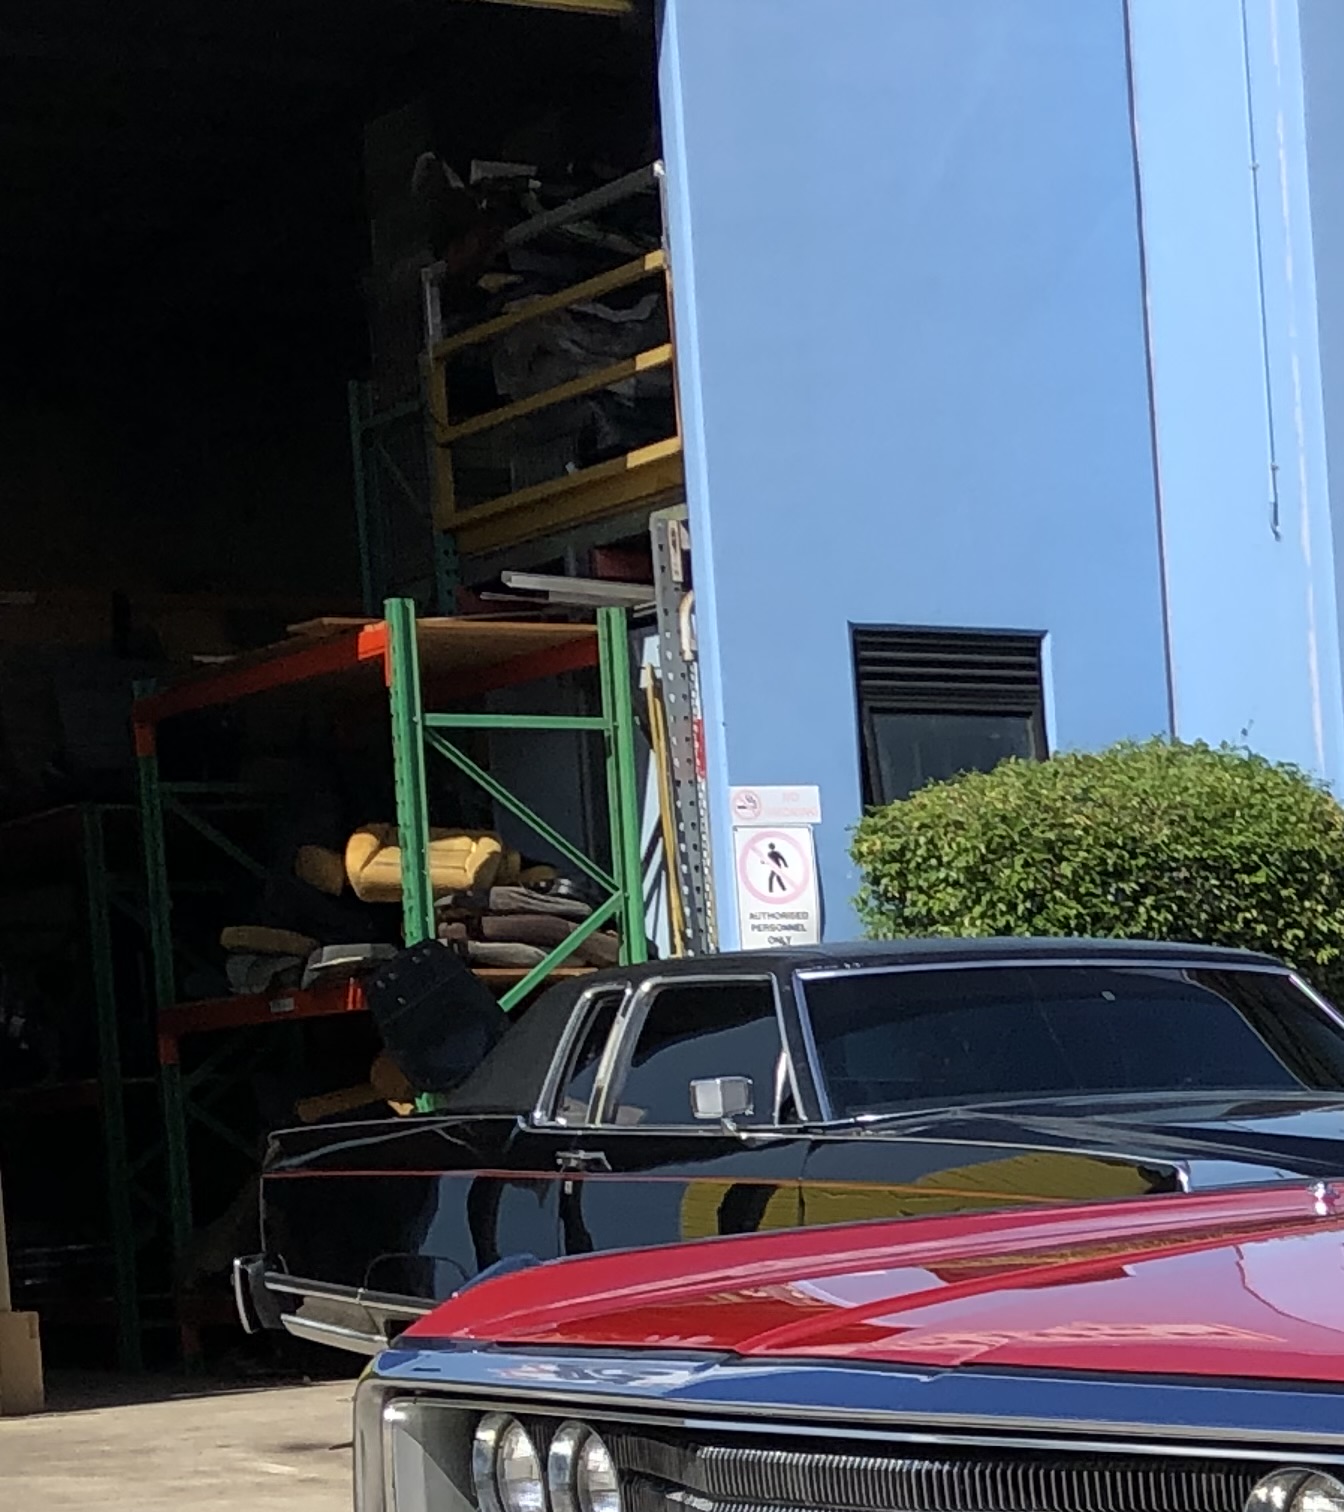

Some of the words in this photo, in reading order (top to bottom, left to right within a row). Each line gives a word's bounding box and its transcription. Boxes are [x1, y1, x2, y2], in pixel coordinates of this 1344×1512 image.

[749, 911, 808, 920] AUTHORISED
[751, 923, 807, 932] PERSONNEL
[768, 935, 791, 945] ONLY
